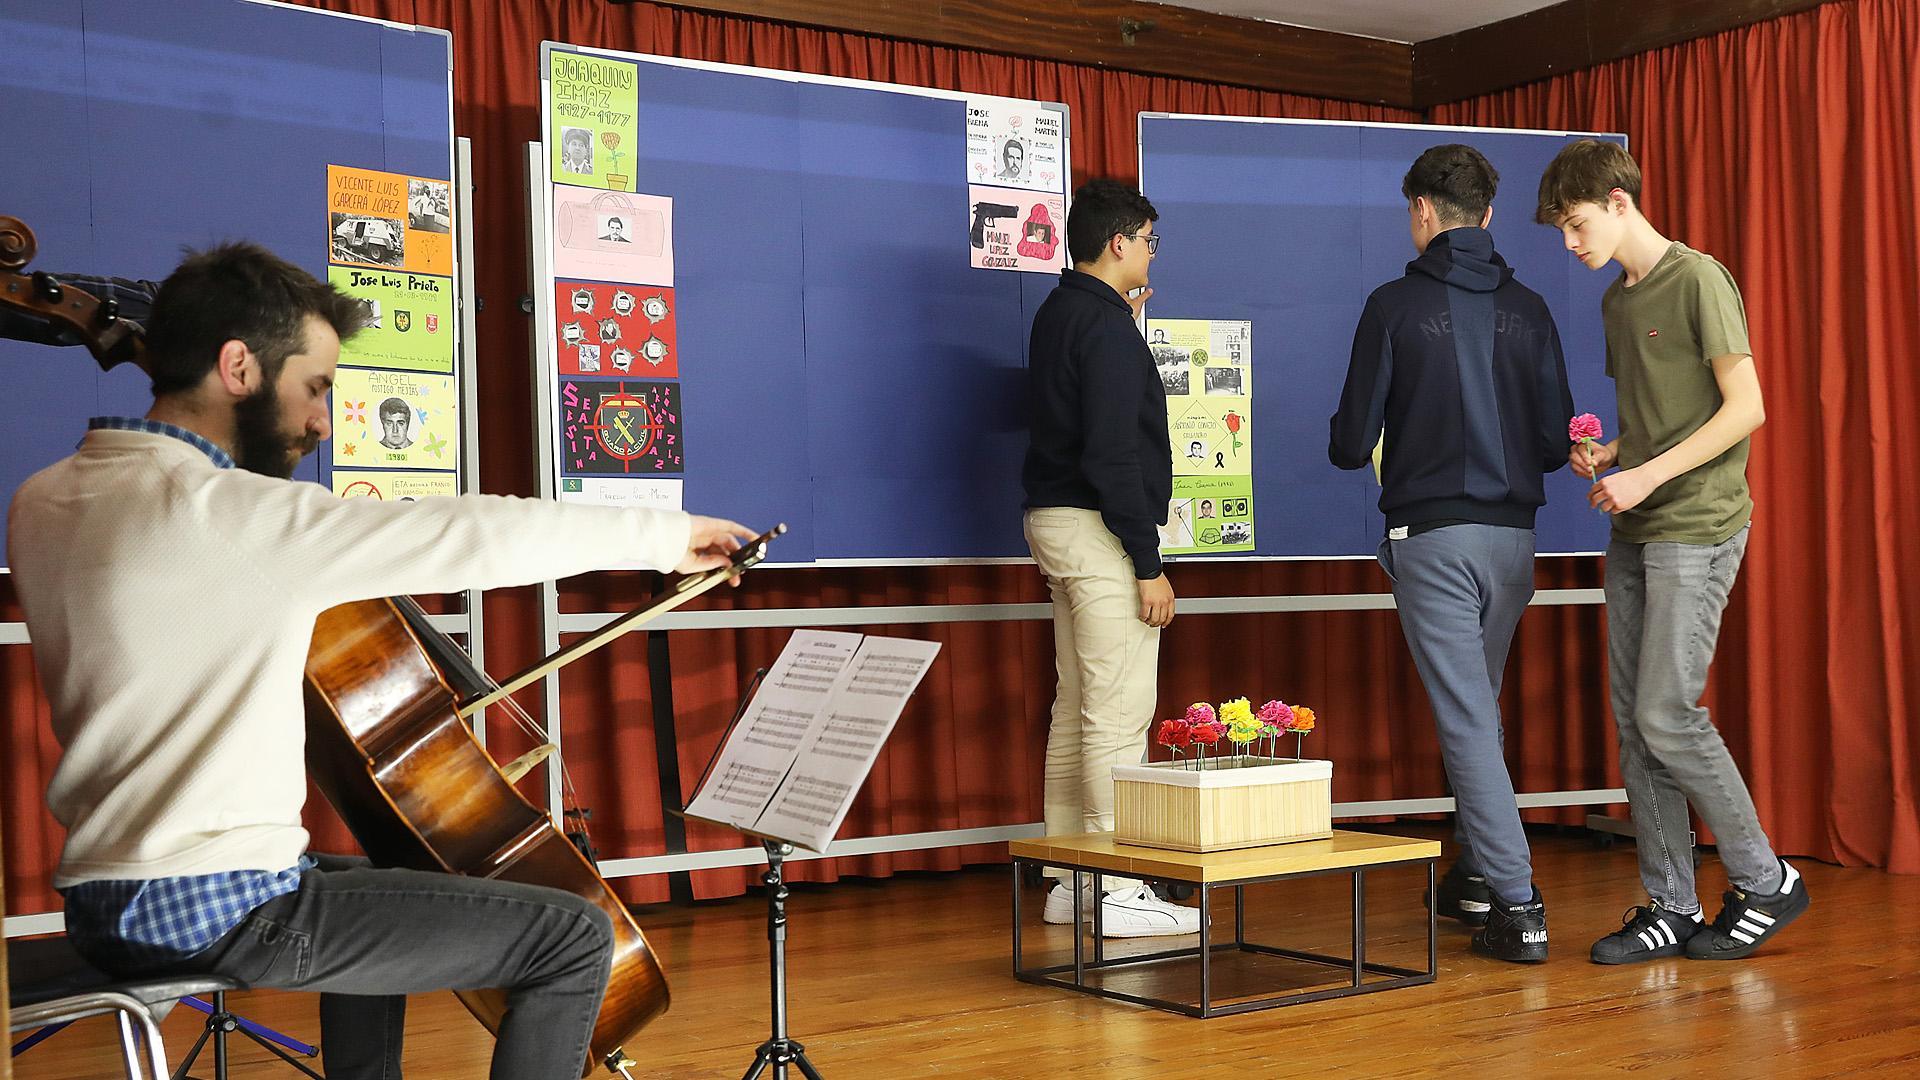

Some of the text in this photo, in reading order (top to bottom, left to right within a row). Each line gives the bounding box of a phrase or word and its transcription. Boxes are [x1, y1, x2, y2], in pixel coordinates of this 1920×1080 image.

[555, 57, 633, 90] JOAQUIN
[556, 80, 612, 108] IMAZ
[335, 175, 399, 196] VICENTE LUIS
[350, 271, 440, 293] Jose Luis Prieto
